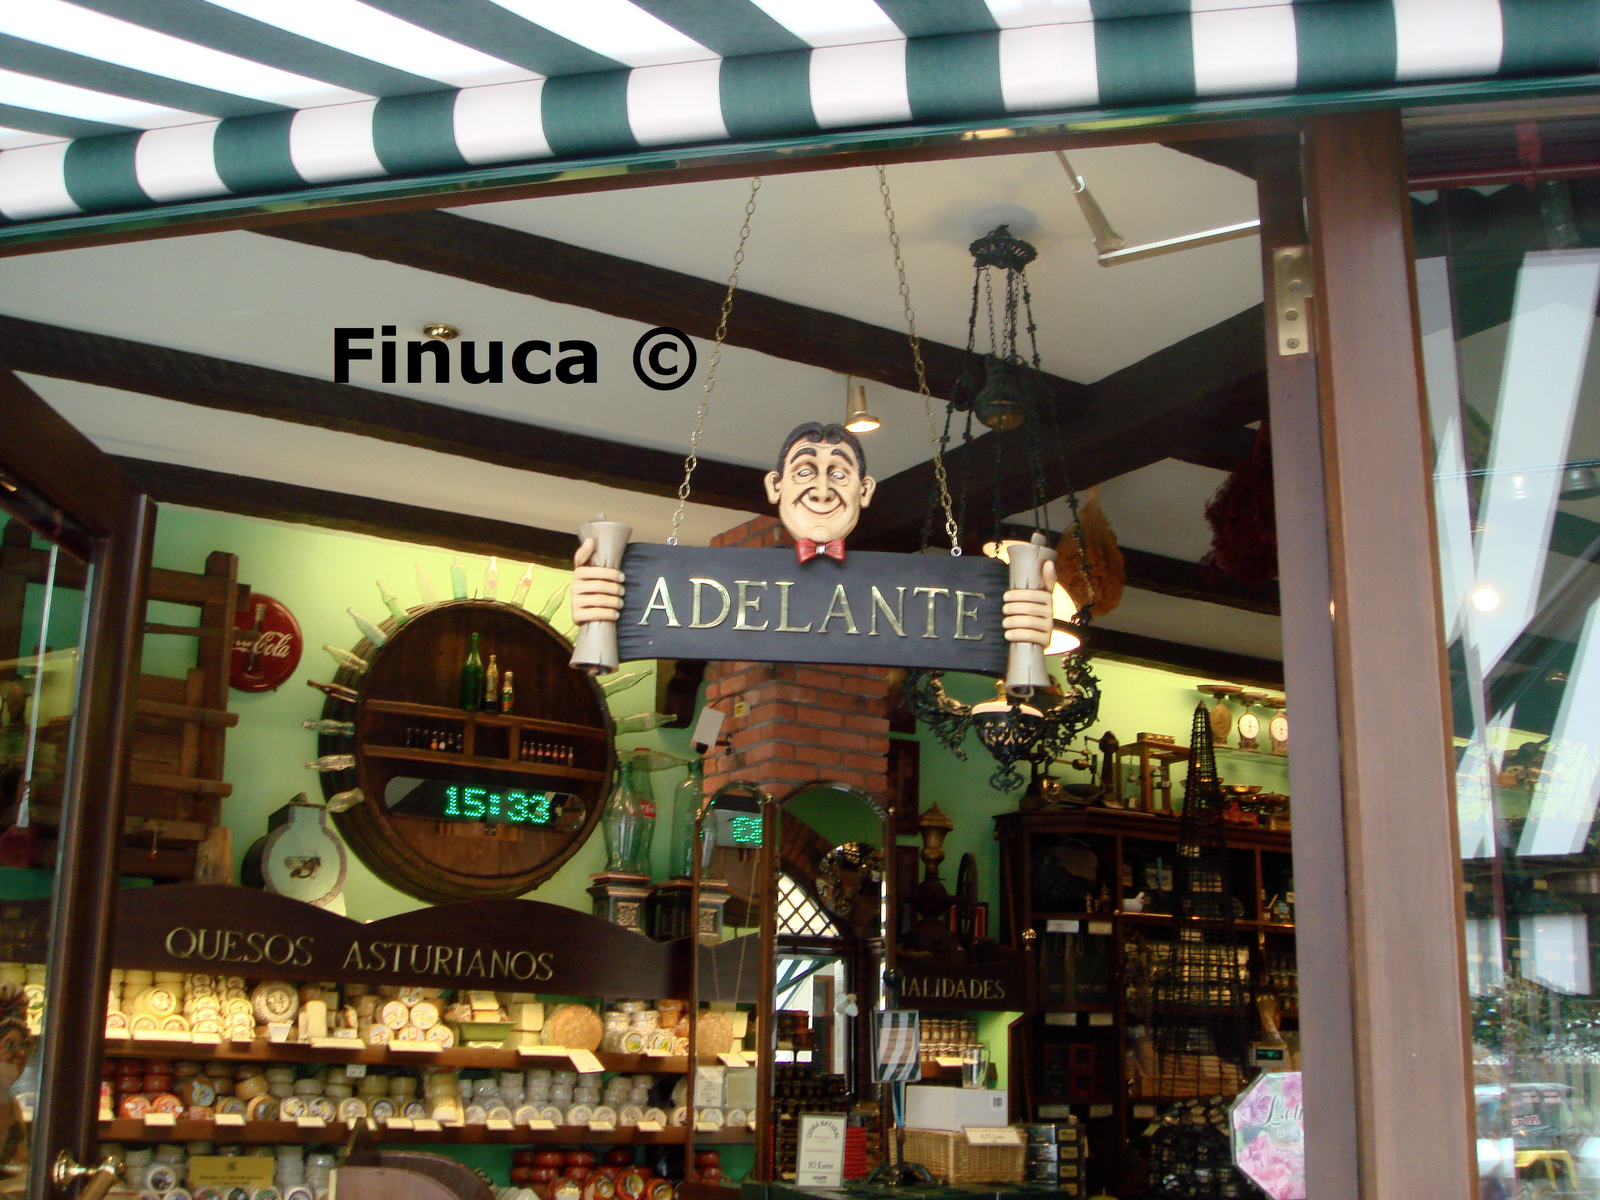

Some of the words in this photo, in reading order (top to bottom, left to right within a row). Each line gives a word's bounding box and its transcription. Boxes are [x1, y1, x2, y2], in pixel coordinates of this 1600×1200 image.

[637, 576, 986, 641] ADELANTE
[444, 785, 550, 824] 15:33
[165, 926, 314, 967] QUESOS
[342, 940, 554, 982] ASTURIANOS
